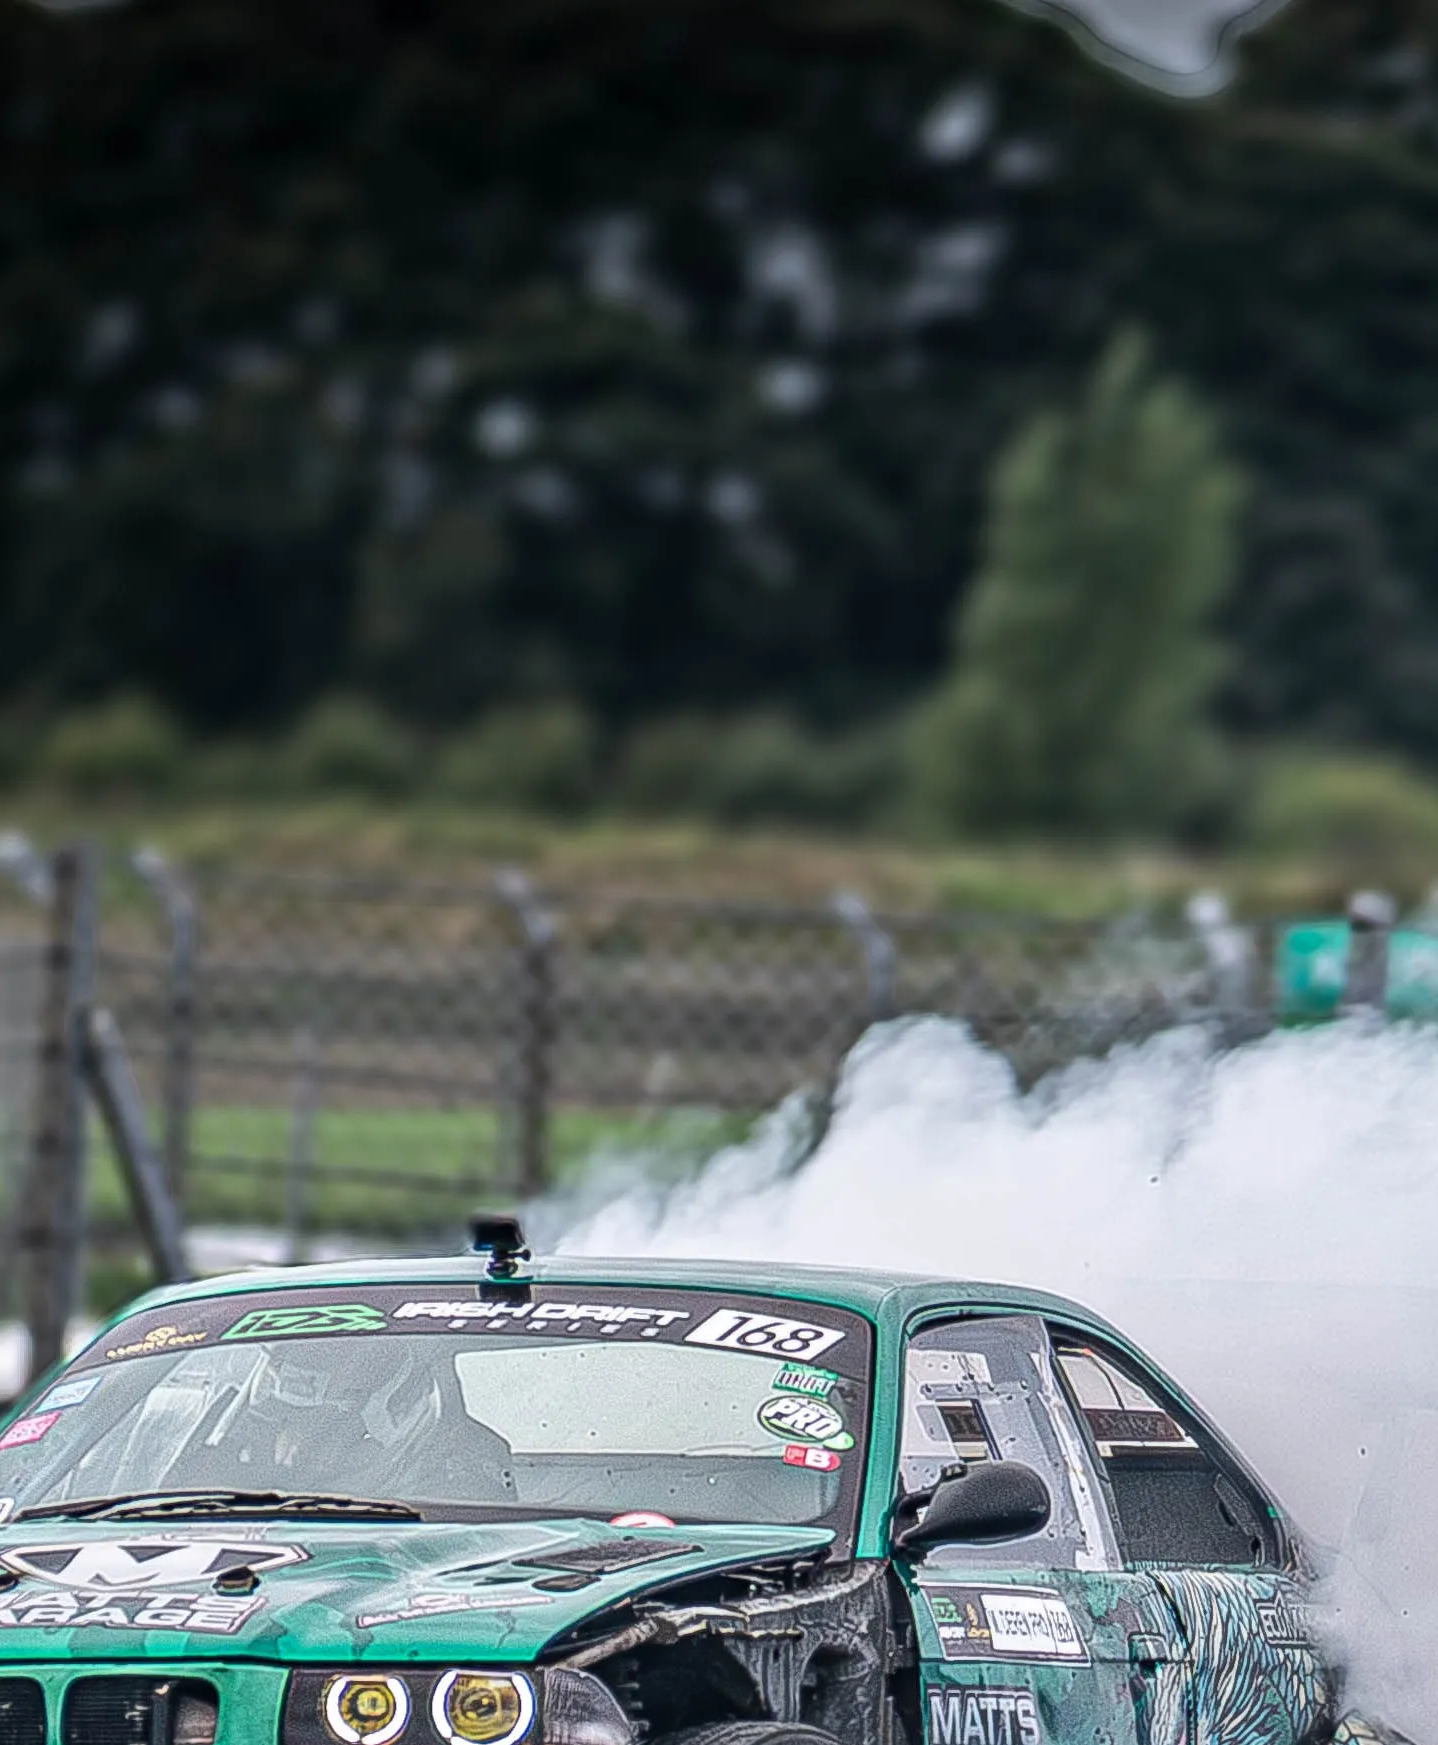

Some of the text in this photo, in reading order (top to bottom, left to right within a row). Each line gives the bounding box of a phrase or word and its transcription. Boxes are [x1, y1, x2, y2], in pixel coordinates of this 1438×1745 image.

[392, 1302, 690, 1326] IRISH DRIFT
[715, 1315, 824, 1353] 168
[763, 1399, 840, 1439] PRO
